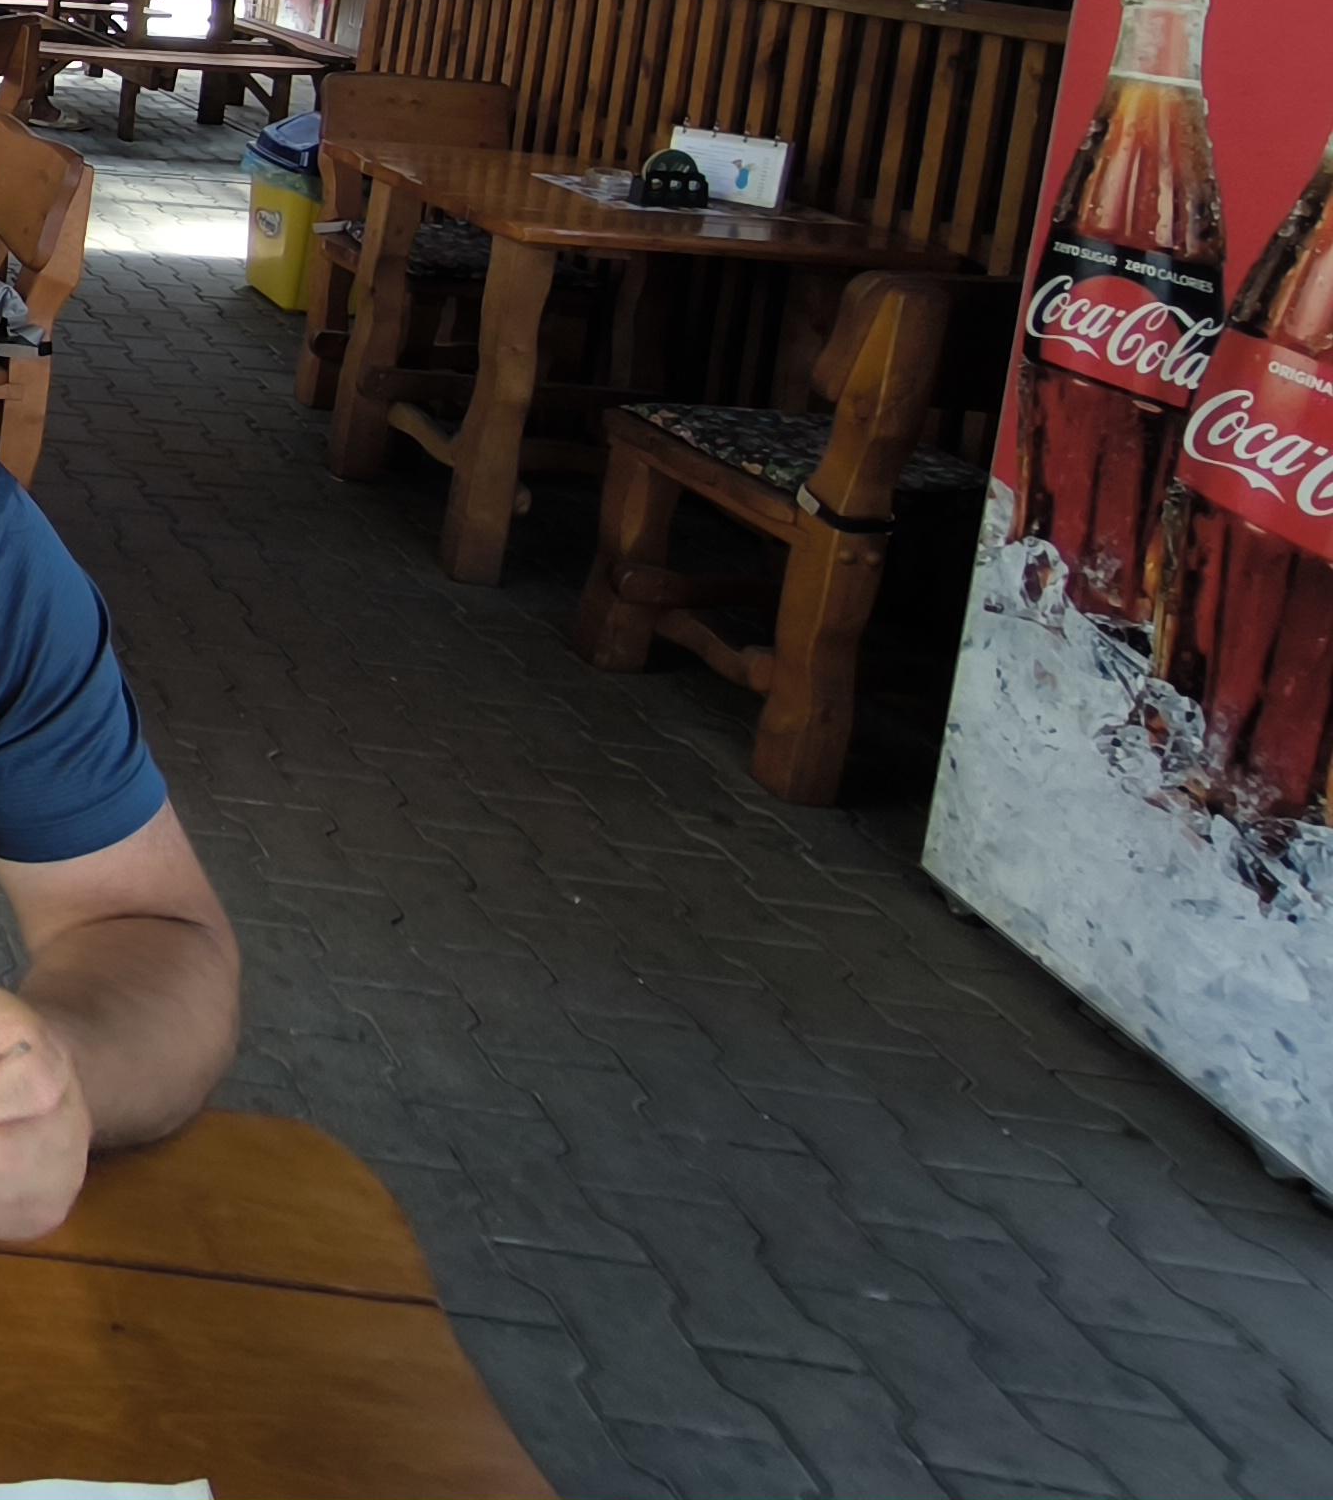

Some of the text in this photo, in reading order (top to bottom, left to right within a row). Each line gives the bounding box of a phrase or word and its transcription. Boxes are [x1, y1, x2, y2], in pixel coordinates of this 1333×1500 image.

[1052, 241, 1214, 294] zero SUGAR zero CALORIES
